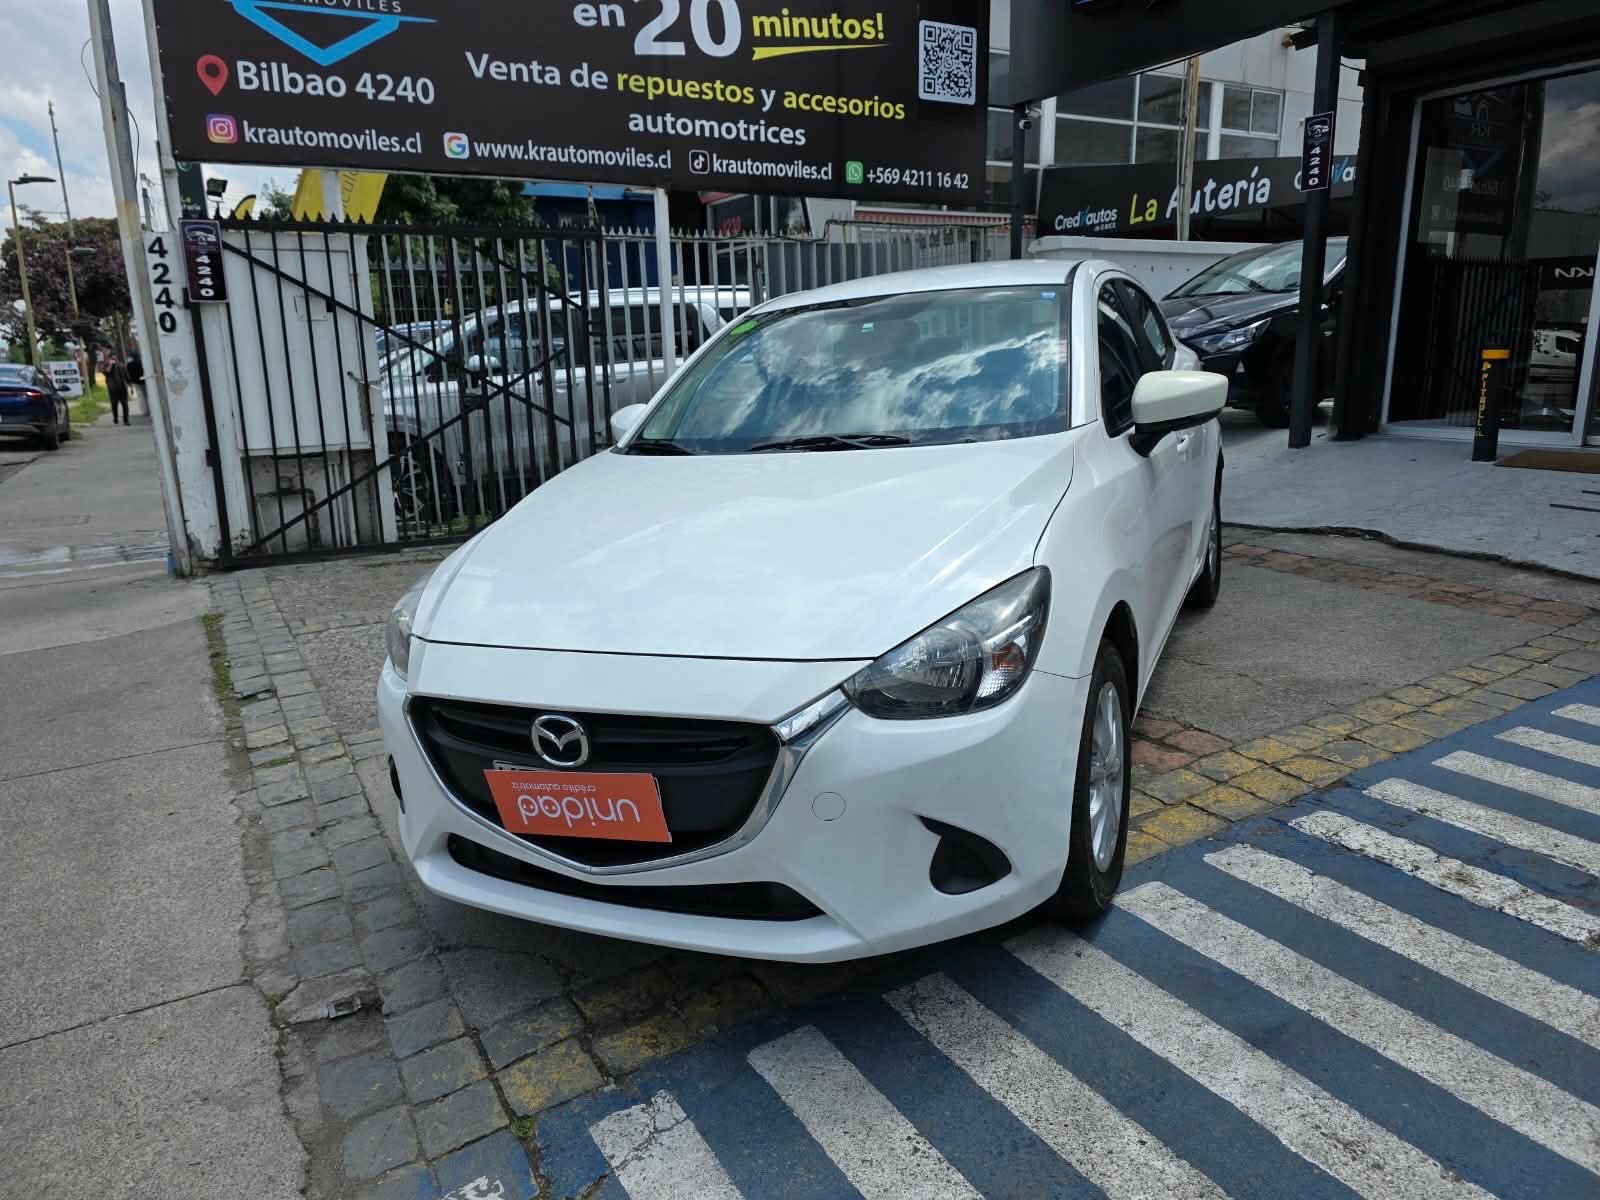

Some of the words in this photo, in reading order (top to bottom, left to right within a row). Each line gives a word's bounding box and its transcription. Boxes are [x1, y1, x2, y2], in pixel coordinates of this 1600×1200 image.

[573, 3, 625, 27] en
[634, 0, 741, 57] 20
[752, 8, 884, 40] minutos!
[236, 60, 347, 98] Bilbao
[355, 72, 434, 105] 4240
[465, 51, 561, 86] Venta
[570, 62, 609, 90] de
[617, 72, 754, 104] repuestos
[761, 88, 776, 112] y
[784, 90, 906, 120] accesorios
[243, 120, 422, 154] krautomoviles.cl
[628, 112, 807, 146] automotrices
[473, 140, 671, 169] www.krautomoviles.cl
[713, 153, 832, 181] krautomoviles.cl
[1308, 146, 1321, 186] 4240
[867, 167, 900, 185] +569
[902, 169, 933, 187] 4211
[937, 172, 951, 188] 16
[953, 173, 969, 189] 42
[1130, 193, 1158, 225] La
[148, 236, 177, 334] 4240
[195, 254, 216, 297] 4240
[511, 781, 561, 793] automotriz
[517, 794, 641, 828] unidad
